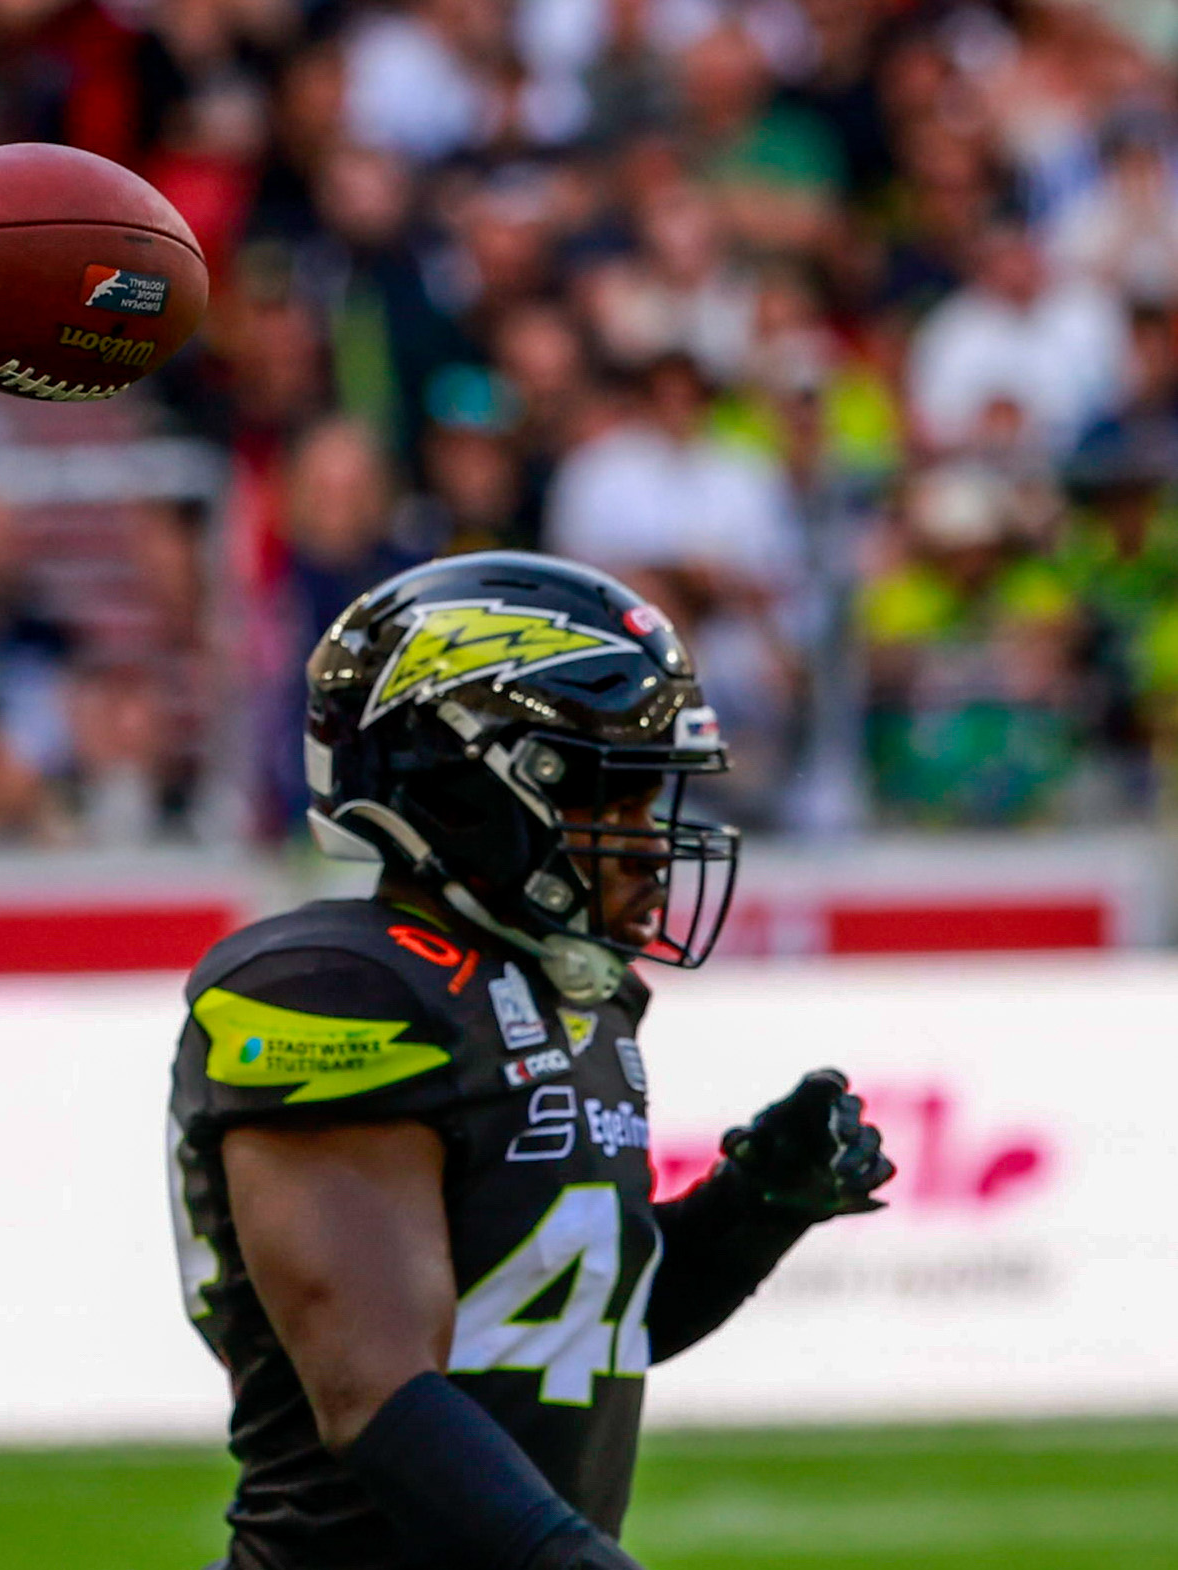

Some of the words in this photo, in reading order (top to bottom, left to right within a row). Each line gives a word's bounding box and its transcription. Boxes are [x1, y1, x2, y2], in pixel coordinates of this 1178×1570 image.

[60, 326, 155, 365] Wilson
[267, 1040, 381, 1056] STADTWERKE
[267, 1057, 366, 1073] STUTTGART
